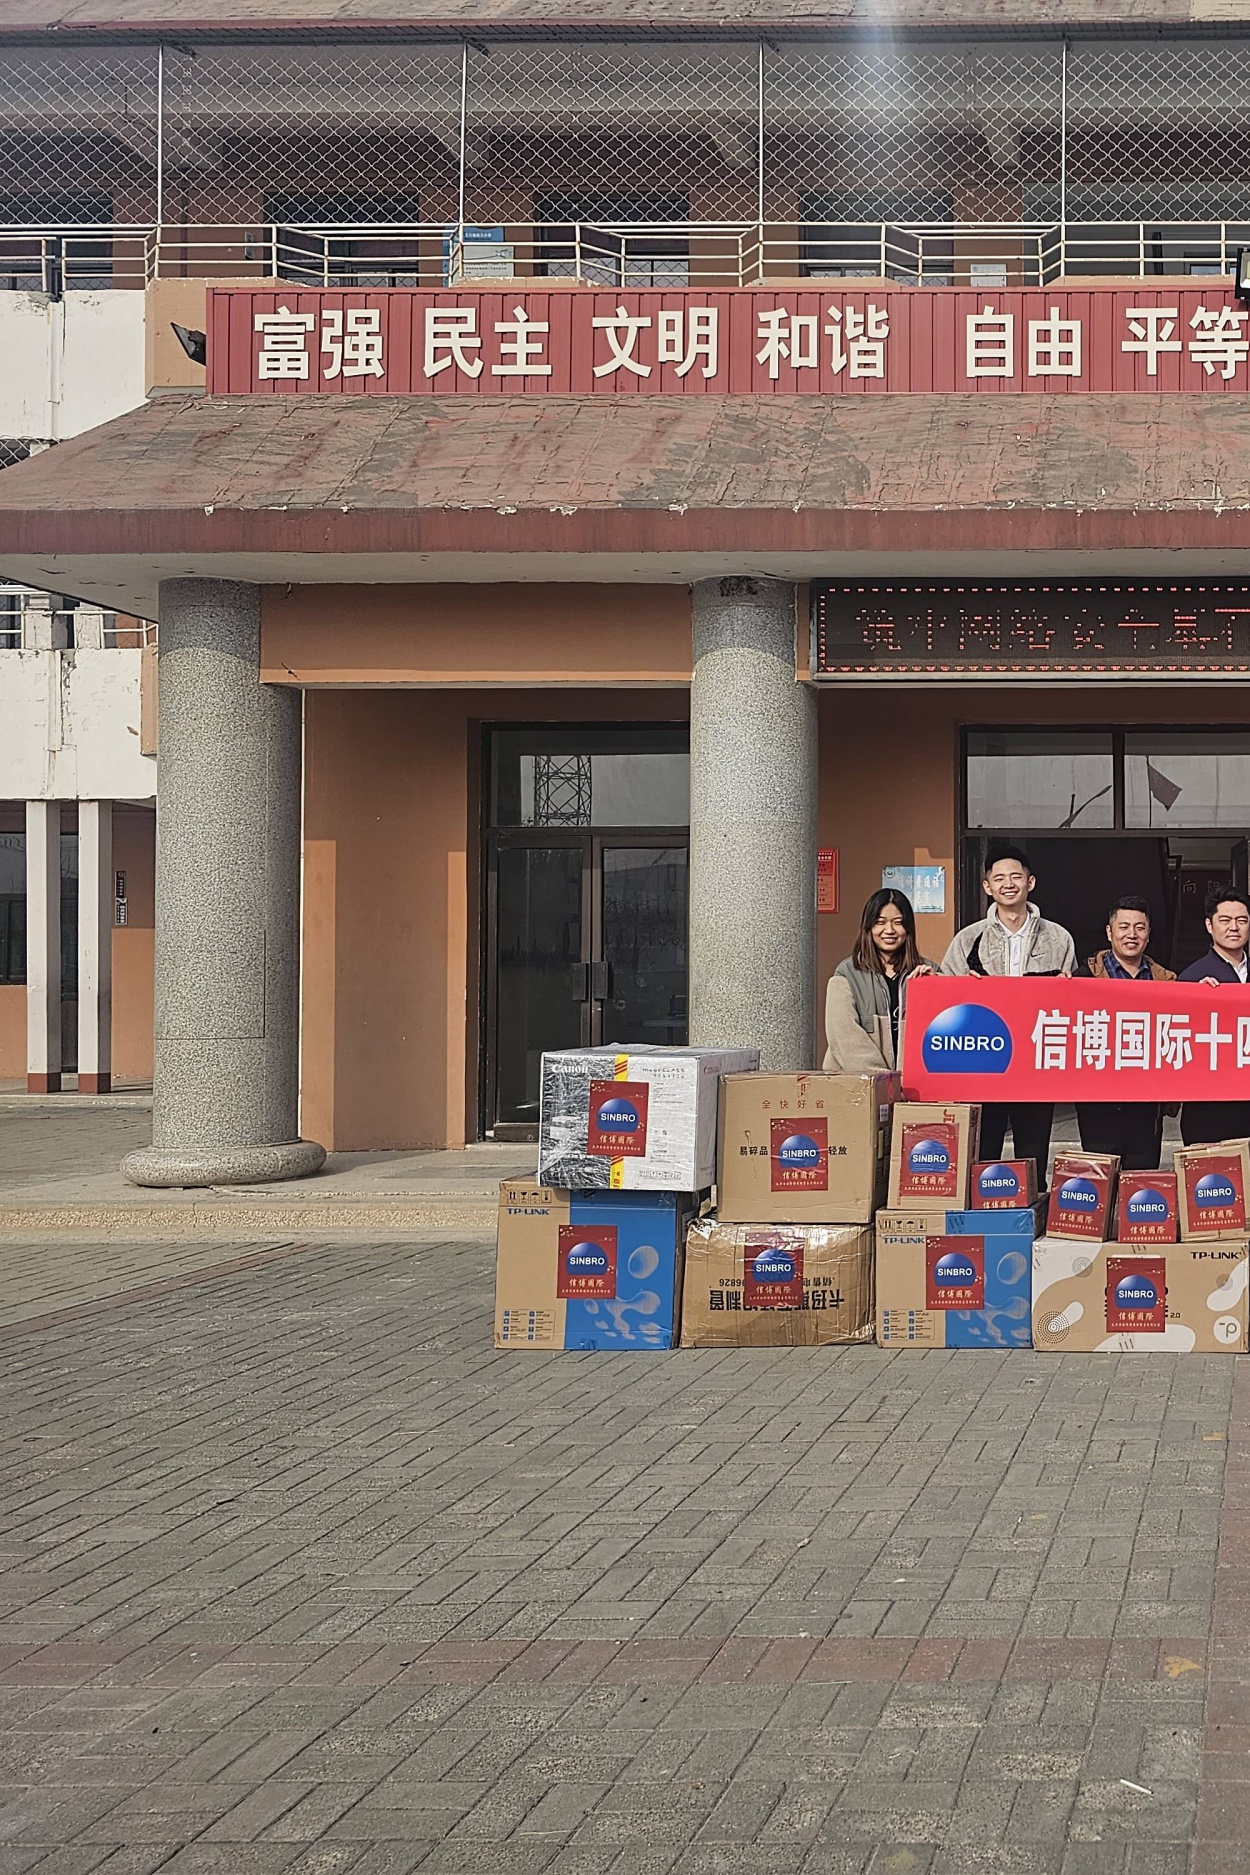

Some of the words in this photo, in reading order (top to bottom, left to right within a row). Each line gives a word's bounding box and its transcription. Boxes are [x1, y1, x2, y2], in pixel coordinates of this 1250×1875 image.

[254, 306, 384, 380] 富强
[423, 306, 552, 378] 民主
[592, 306, 719, 378] 文明
[756, 304, 890, 379] 和谐
[966, 305, 1083, 378] 自由
[1121, 306, 1250, 380] 平等
[930, 1034, 1005, 1052] SINBRO
[551, 1064, 589, 1074] Canon
[601, 1113, 636, 1122] SINBRO
[739, 1146, 769, 1156] 易碎品
[828, 1145, 848, 1156] 轻放
[782, 1149, 817, 1158] SINBRO
[912, 1154, 947, 1163] SINBRO
[981, 1178, 1016, 1188] SINBRO
[1061, 1190, 1096, 1203] SINBRO
[1197, 1187, 1232, 1198] SINBRO
[1130, 1204, 1165, 1213] SINBRO
[1190, 1251, 1240, 1260] TP-LINK
[570, 1257, 605, 1265] SINBRO
[756, 1263, 792, 1272] SINBRO
[937, 1267, 973, 1277] SINBRO
[1118, 1290, 1154, 1298] SINBRO
